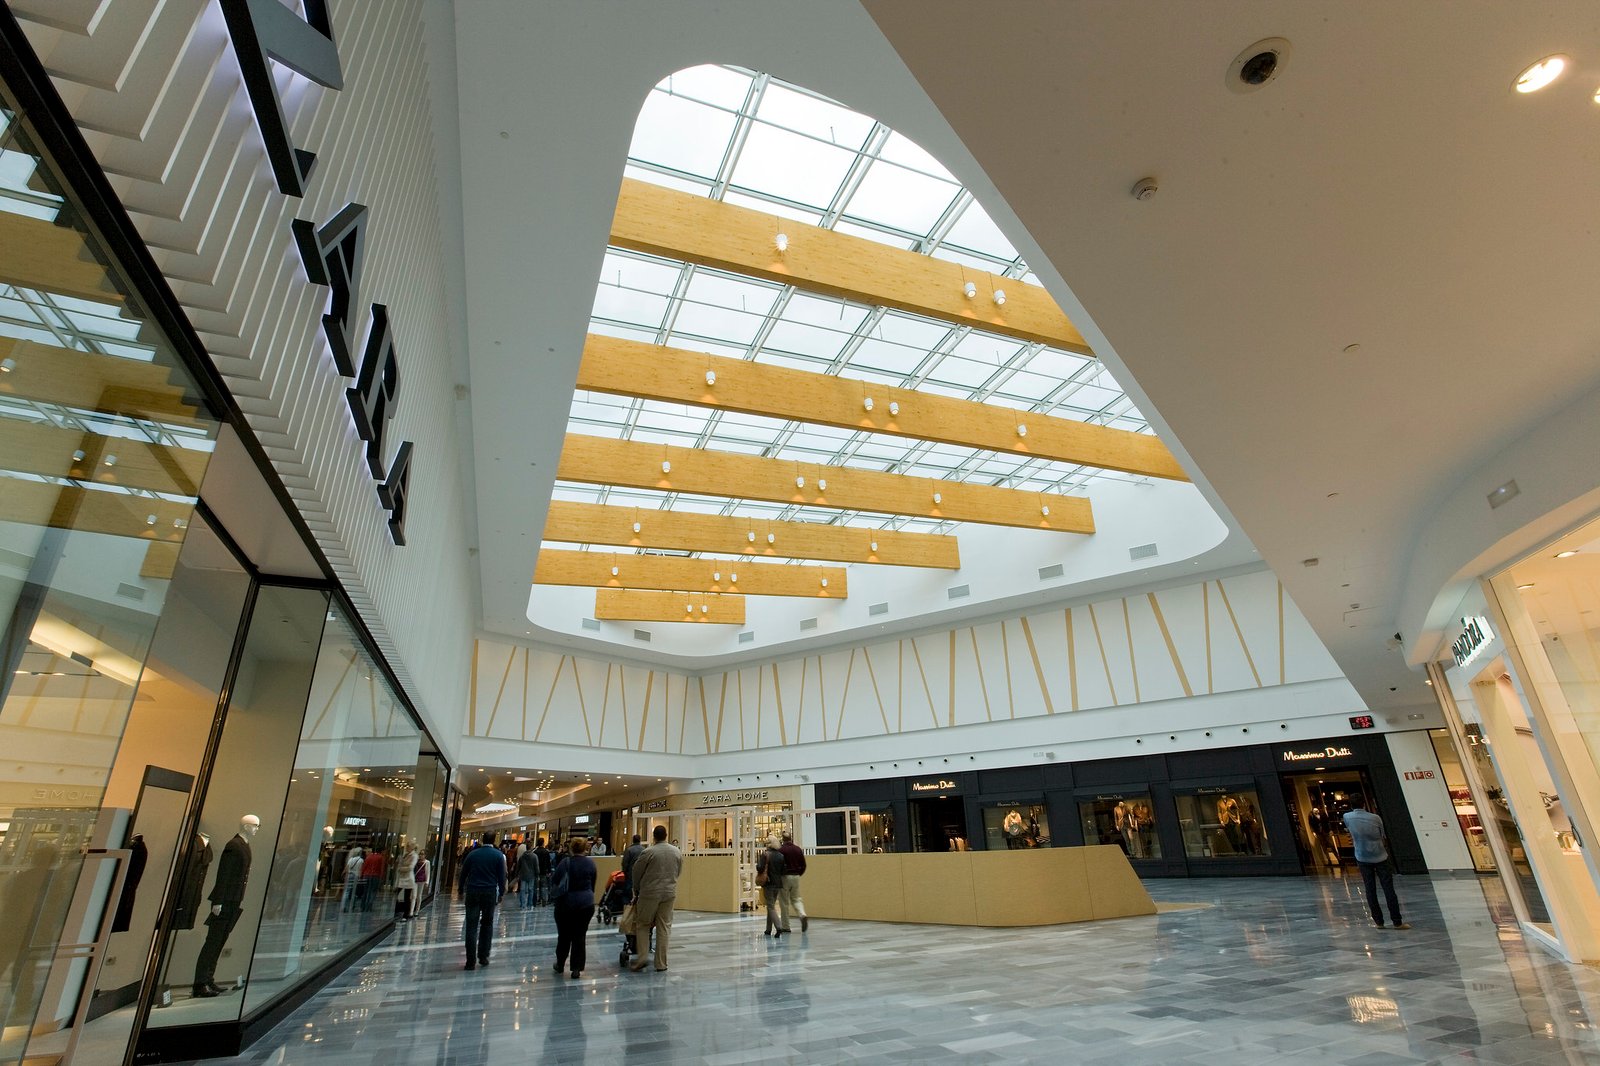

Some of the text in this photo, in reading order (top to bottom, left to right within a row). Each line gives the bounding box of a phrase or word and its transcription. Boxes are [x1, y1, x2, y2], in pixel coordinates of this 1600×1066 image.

[1283, 747, 1353, 761] Massimo Dutti
[912, 780, 956, 791] Massimo Dutti
[702, 790, 769, 804] ZARA HOME
